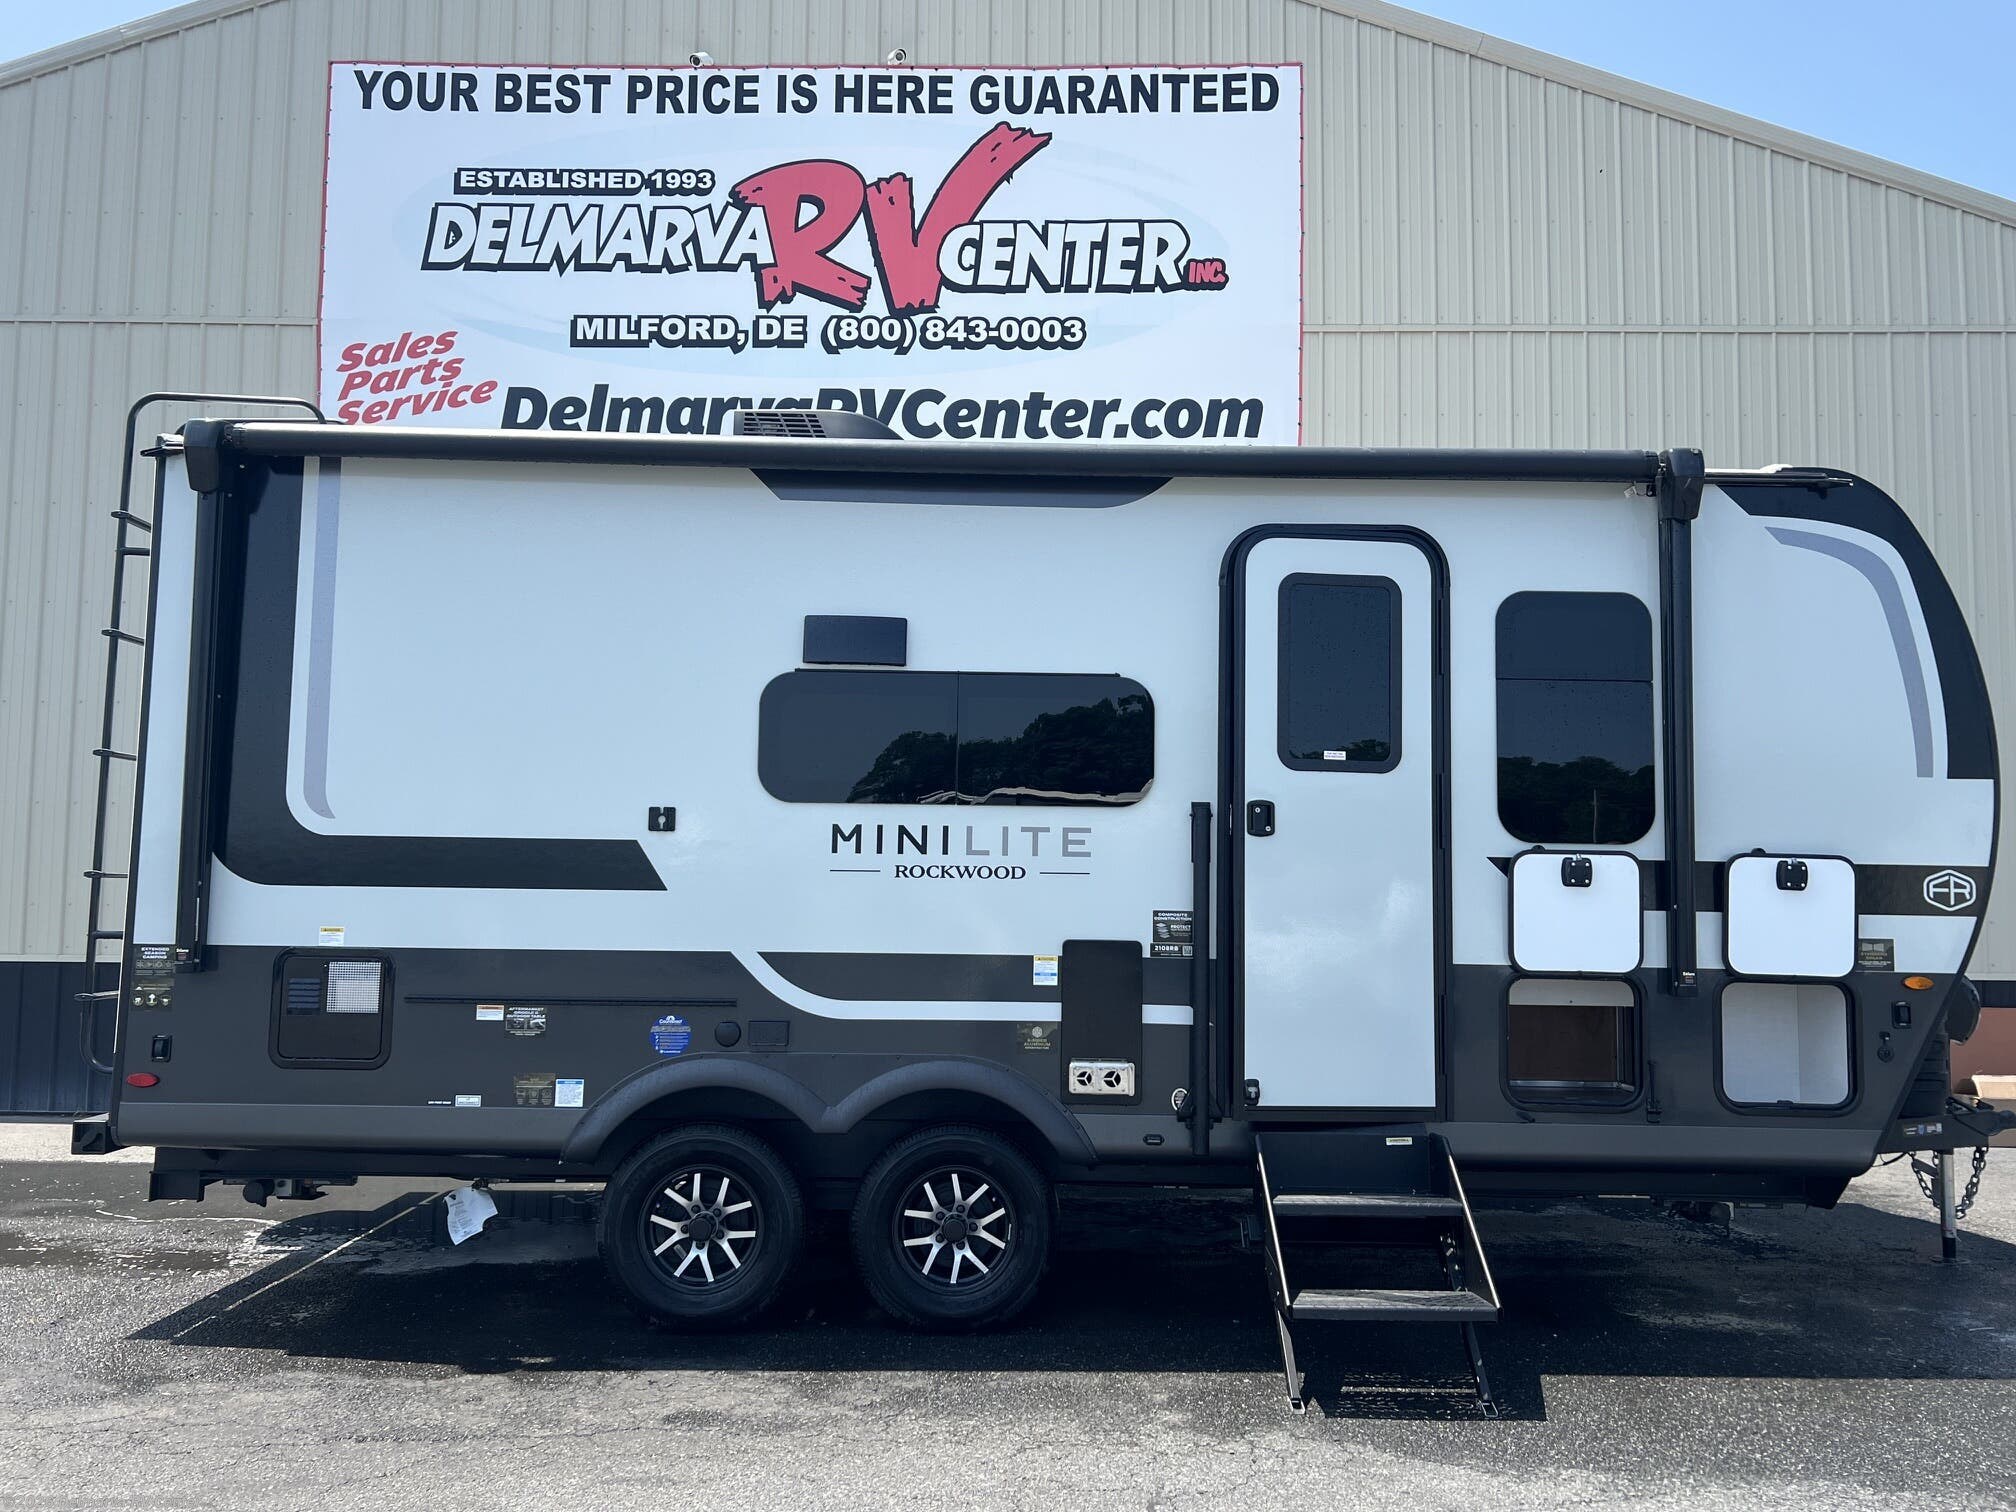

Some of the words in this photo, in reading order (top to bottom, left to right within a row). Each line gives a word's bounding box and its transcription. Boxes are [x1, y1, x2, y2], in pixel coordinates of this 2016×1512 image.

[354, 70, 478, 112] YOUR
[495, 73, 611, 114] BEST
[627, 74, 760, 115] PRICE
[777, 74, 818, 115] IS
[834, 74, 953, 114] HERE
[970, 72, 1280, 115] GUARANTEED
[455, 169, 644, 193] ESTABLISHED
[649, 170, 714, 193] 1993
[422, 203, 777, 273] DELMARVA
[729, 122, 1052, 313] RV
[937, 220, 1190, 293] CENTER
[1186, 259, 1228, 288] INC.
[336, 331, 458, 372] Sales
[573, 316, 748, 350] MILFORD,
[756, 315, 808, 346] DE
[823, 317, 915, 352] (800)
[923, 317, 1085, 347] 843-0003
[337, 357, 465, 401] Parts
[338, 380, 498, 425] Service
[832, 824, 1092, 857] MINILITE
[895, 865, 1026, 880] ROCKWOOD
